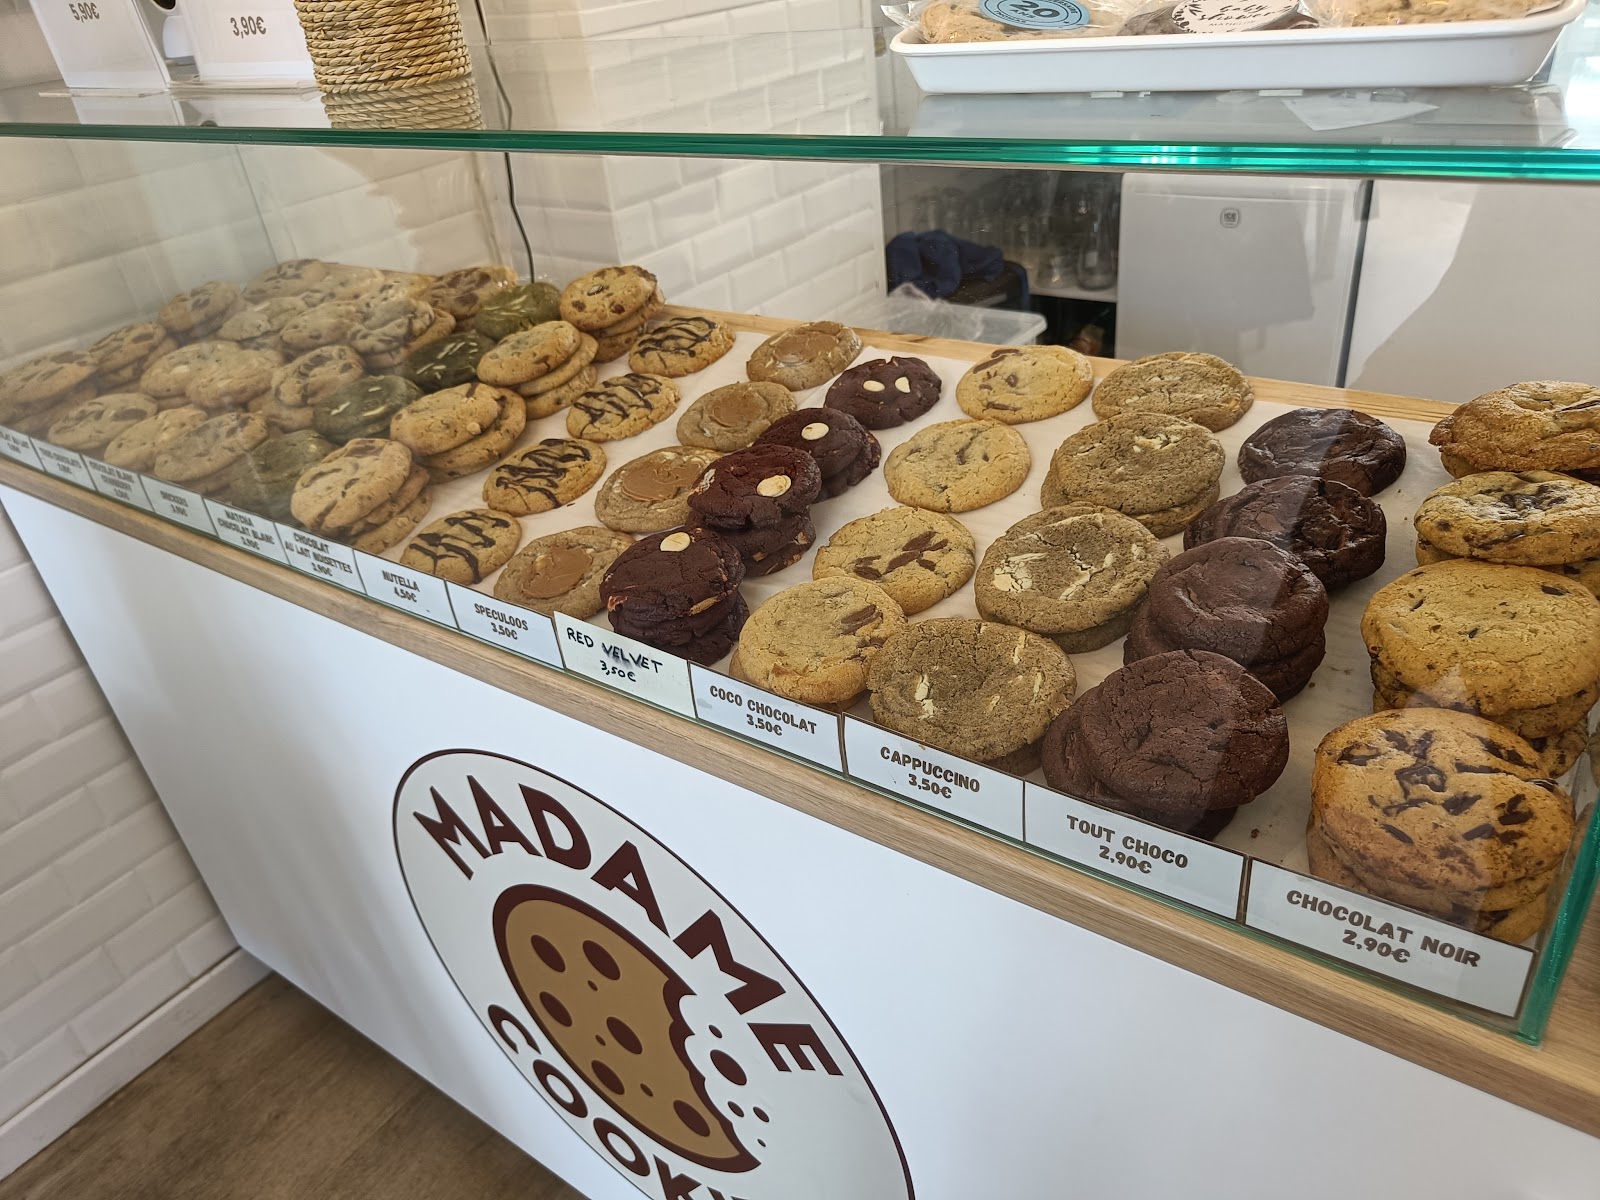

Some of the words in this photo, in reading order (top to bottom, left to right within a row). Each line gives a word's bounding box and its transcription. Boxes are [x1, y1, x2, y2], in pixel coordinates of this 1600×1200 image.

[69, 2, 100, 23] 5,90€
[1009, 0, 1060, 18] 20
[1010, 9, 1036, 19] ANS
[230, 16, 266, 38] 3,90€
[218, 518, 251, 539] CHOCOLAT
[252, 530, 275, 545] BLANC
[225, 509, 254, 527] MATCHA
[294, 532, 329, 554] CHOCOLAT
[285, 541, 295, 552] AU
[295, 545, 312, 559] LAIT
[313, 552, 353, 574] NOISETTES
[382, 570, 421, 593] NUTELLA
[474, 603, 529, 631] SPECULOOS
[490, 622, 518, 640] 3,50€
[566, 627, 594, 648] RED
[601, 642, 663, 673] VELVET
[600, 660, 636, 682] 3,50€
[709, 685, 742, 706] COCO
[747, 699, 817, 734] CHOCOLAT
[746, 713, 782, 736] 3,50€
[880, 747, 980, 792] CAPPUCCINO
[909, 773, 952, 799] 3,50€
[1066, 814, 1115, 843] TOUT
[1122, 836, 1188, 868] CHOCO
[1099, 845, 1152, 874] 2,90€
[413, 775, 844, 1077] MADAME
[1286, 890, 1413, 944] CHOCOLAT
[1420, 935, 1481, 967] NOIR
[1342, 929, 1411, 964] 2,90€
[487, 1004, 750, 1200] COOK
